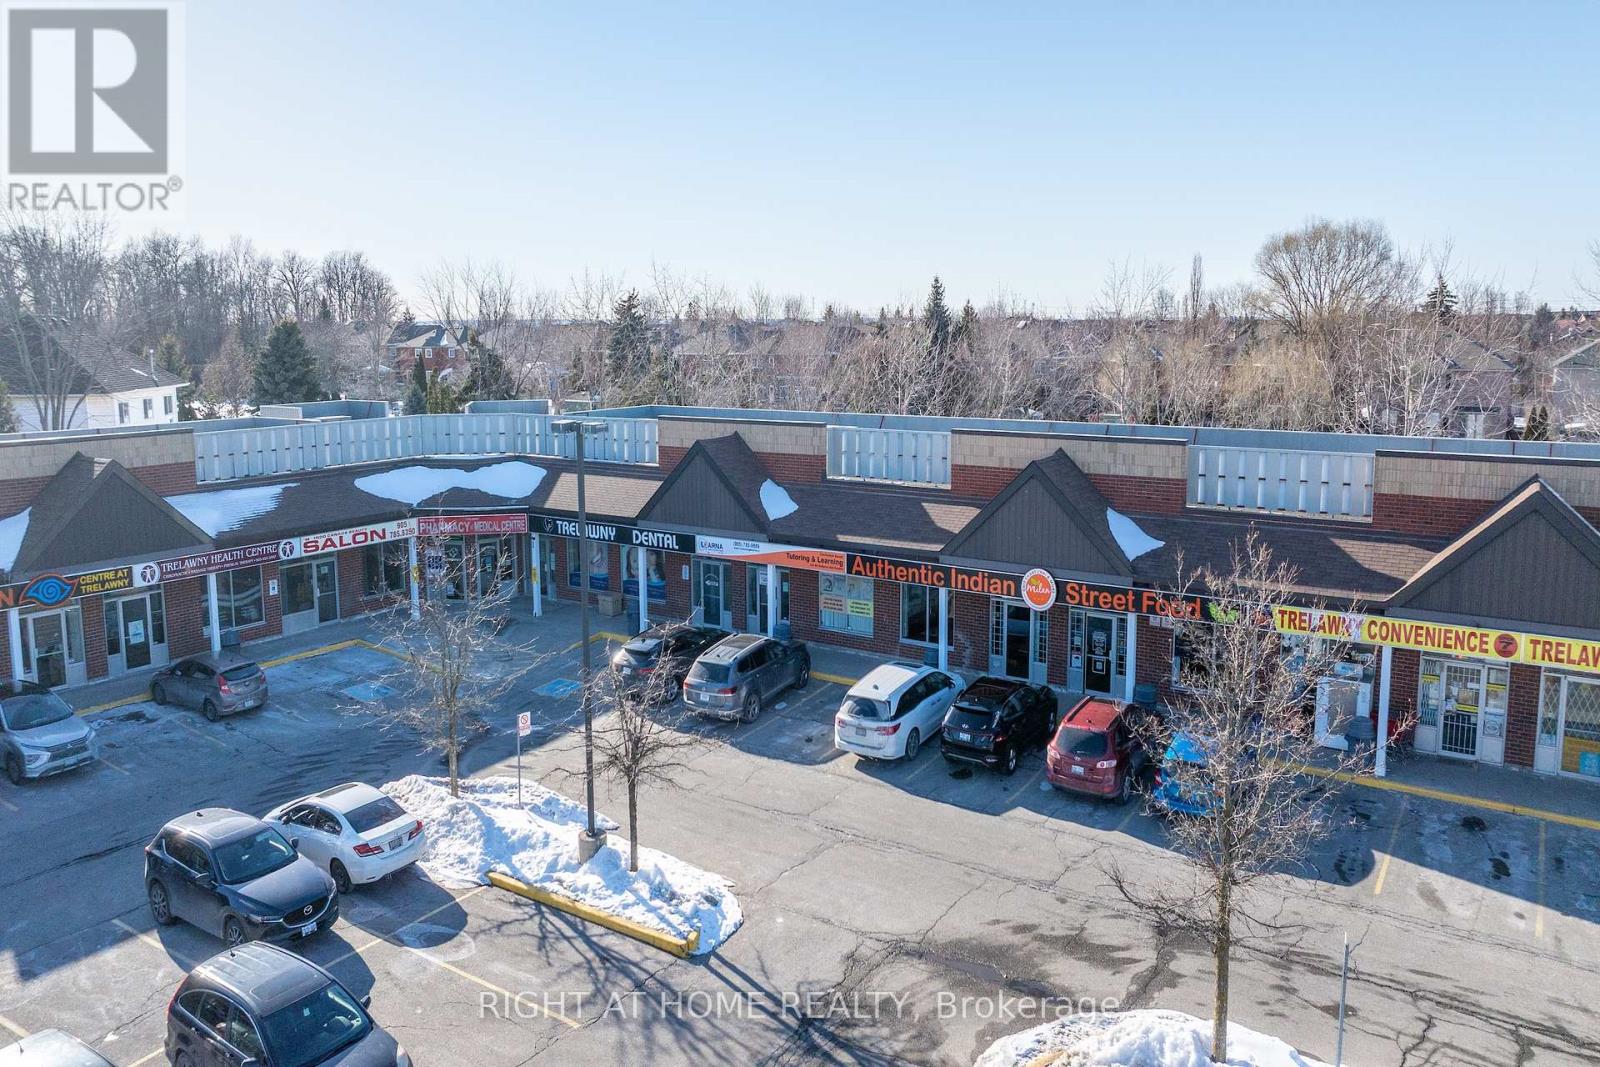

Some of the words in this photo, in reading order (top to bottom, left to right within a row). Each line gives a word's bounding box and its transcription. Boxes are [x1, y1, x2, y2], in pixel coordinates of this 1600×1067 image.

[420, 521, 470, 534] PHARMACY
[474, 521, 500, 532] MEDICAL
[501, 520, 526, 531] CENTRE
[556, 520, 616, 541] TRELWNY
[632, 530, 679, 549] DENTAL
[303, 528, 386, 554] SALON
[161, 555, 209, 572] TRELAWNY
[211, 549, 244, 564] HEALTH
[246, 544, 278, 558] CENTRE
[786, 552, 810, 563] Tutoring
[817, 556, 844, 568] Learning
[80, 570, 117, 584] CENTRE
[117, 569, 129, 578] AT
[81, 578, 129, 594] TRELAWNY
[852, 555, 945, 586] Authentic
[951, 567, 1016, 596] Indian
[1066, 582, 1136, 612] Street
[1142, 591, 1200, 620] Food
[1367, 619, 1490, 654] CONVENIENCE
